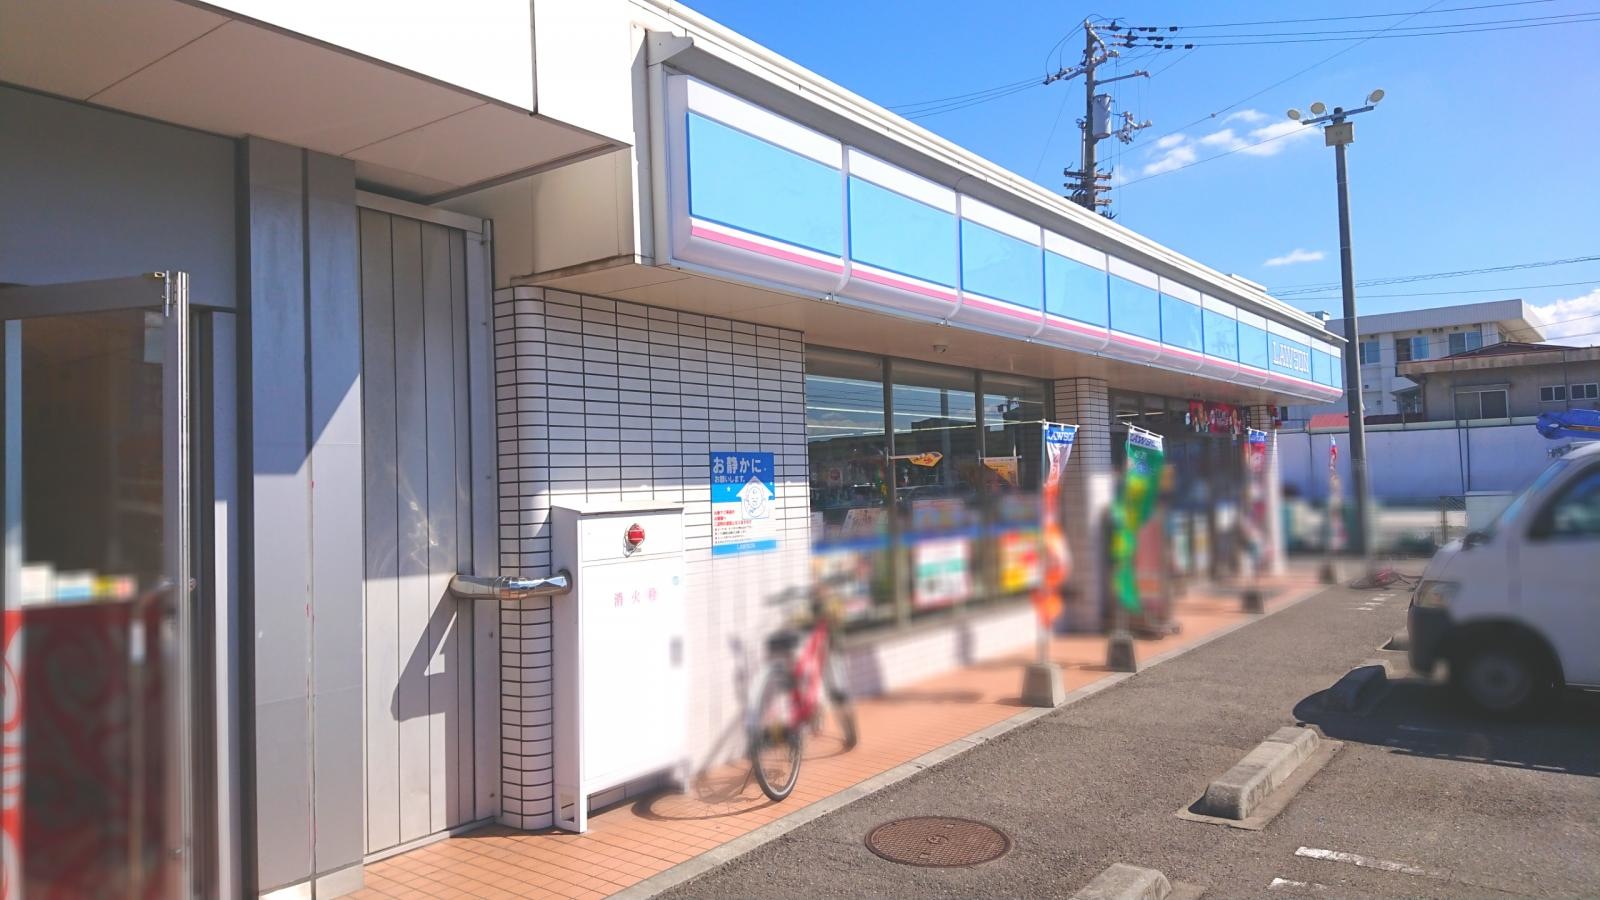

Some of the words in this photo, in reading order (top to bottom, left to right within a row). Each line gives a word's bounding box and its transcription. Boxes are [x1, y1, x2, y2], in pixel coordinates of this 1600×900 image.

[1272, 341, 1309, 373] LAWSON
[713, 456, 762, 474] お静かに
